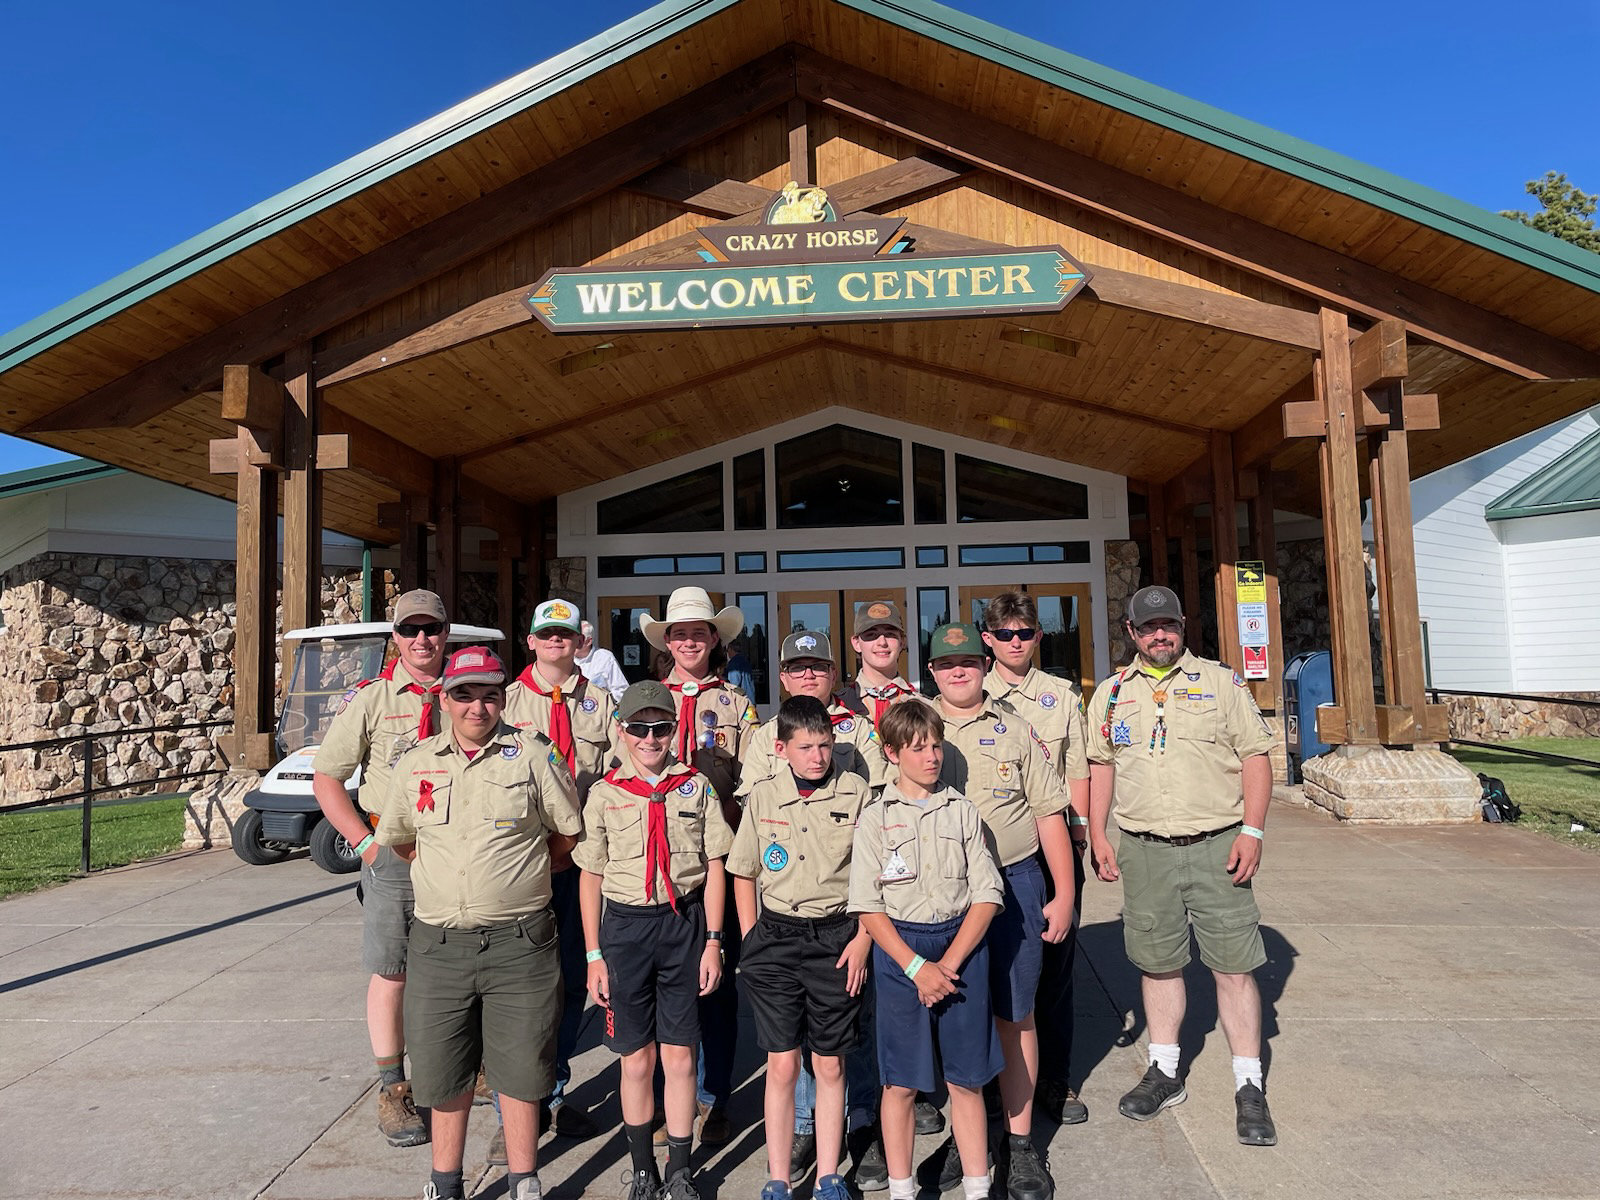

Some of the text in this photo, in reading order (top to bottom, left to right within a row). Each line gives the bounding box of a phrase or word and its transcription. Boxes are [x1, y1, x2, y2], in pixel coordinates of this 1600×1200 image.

[726, 229, 878, 251] CRAZY HORSE
[576, 264, 1036, 314] WELCOME CENTER
